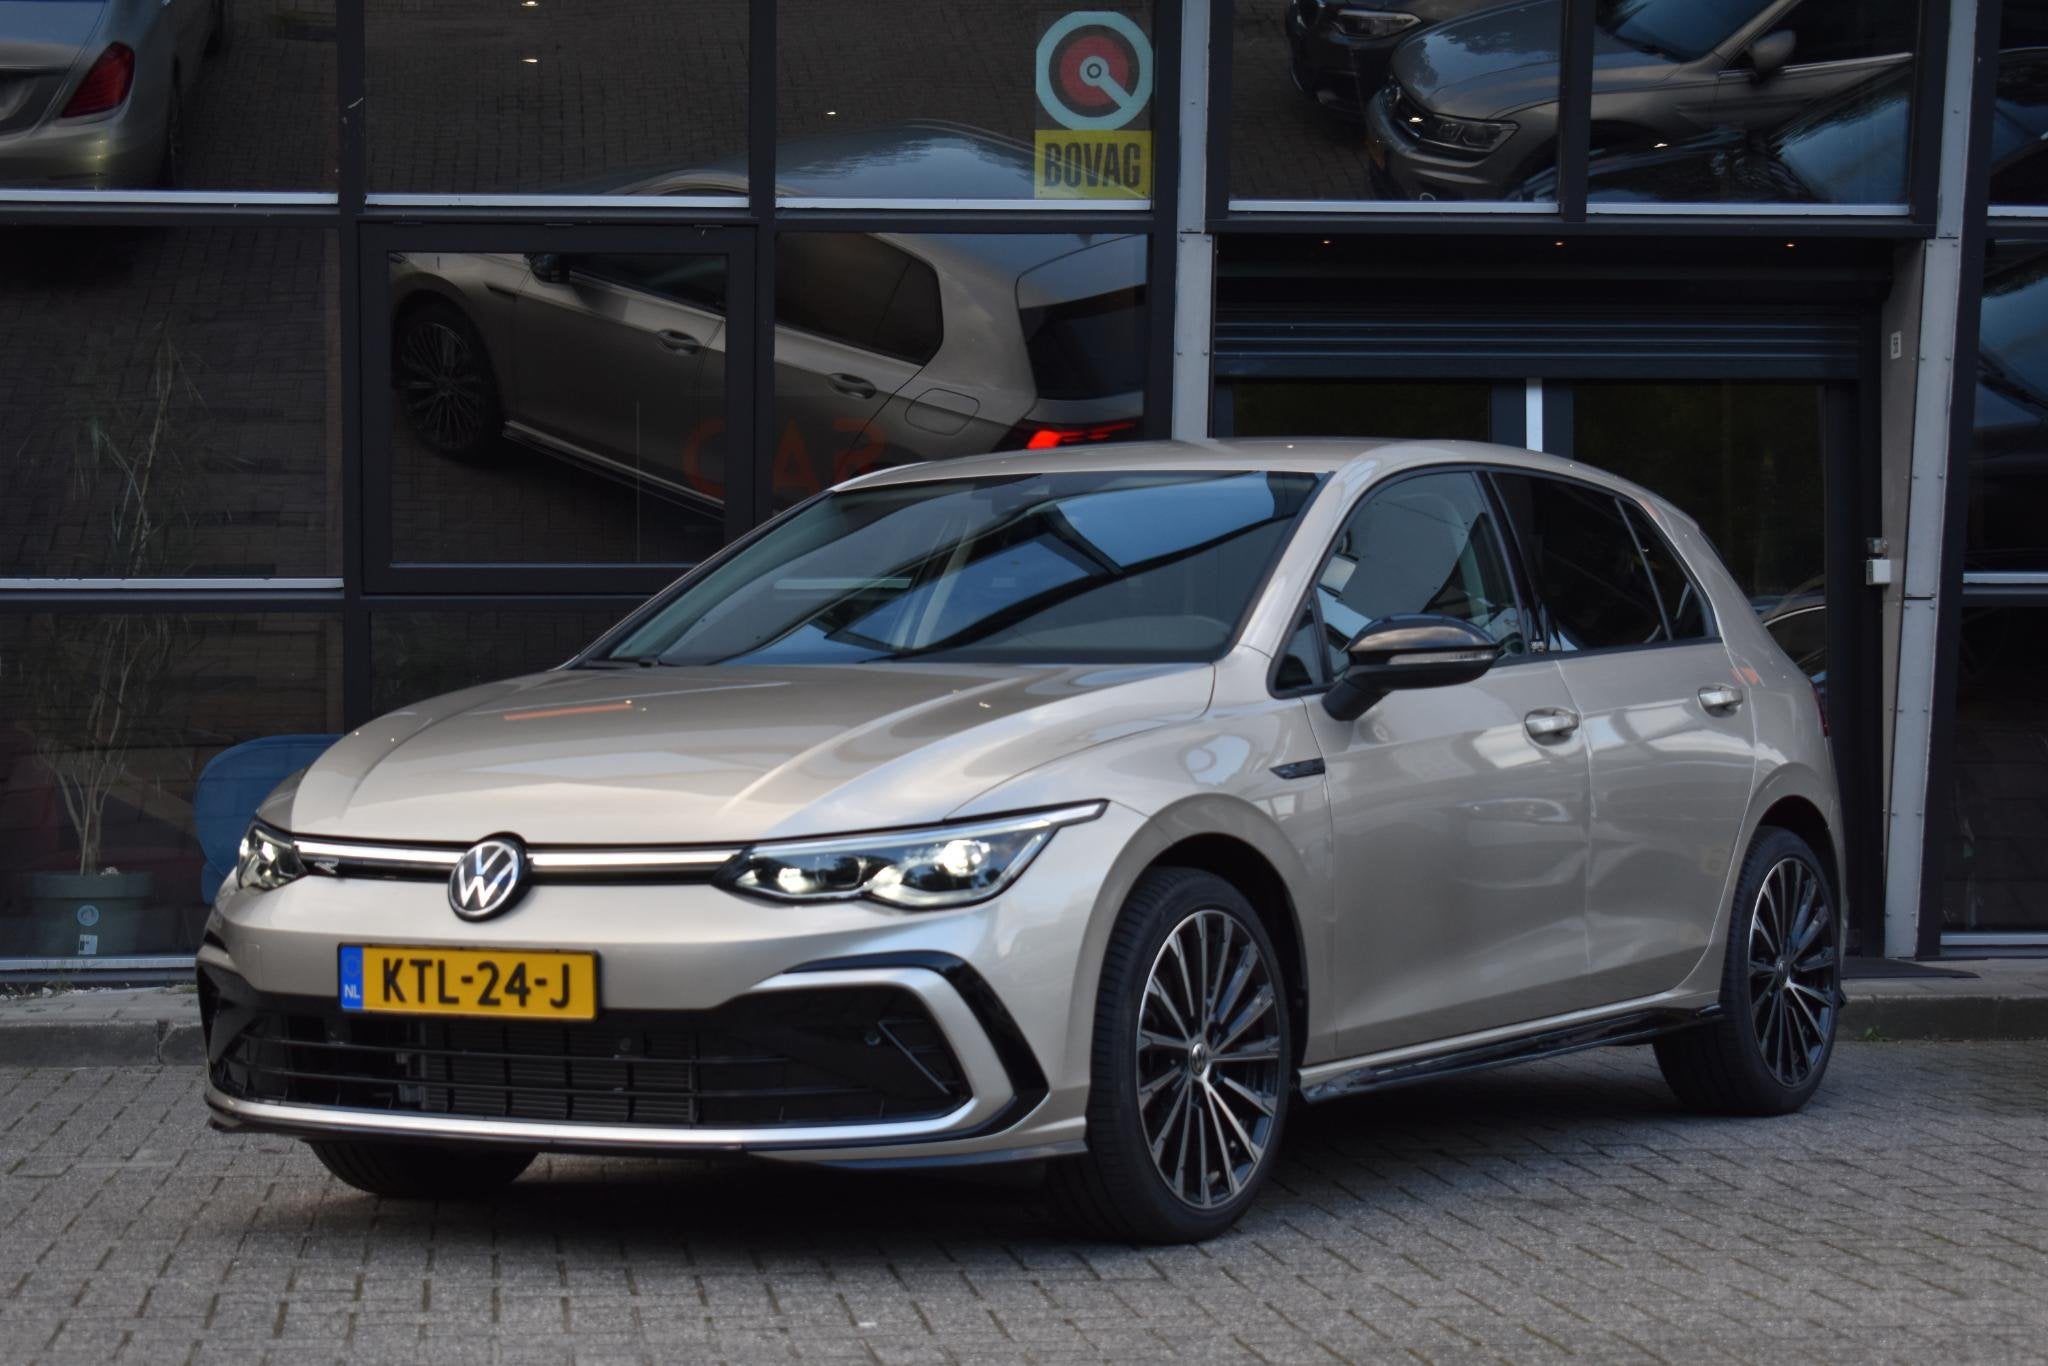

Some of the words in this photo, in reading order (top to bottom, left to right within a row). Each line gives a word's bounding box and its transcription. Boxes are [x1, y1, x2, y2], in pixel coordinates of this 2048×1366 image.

[1044, 142, 1142, 188] BOVAG
[344, 984, 361, 999] NL
[382, 957, 571, 1009] KTL-24-J
